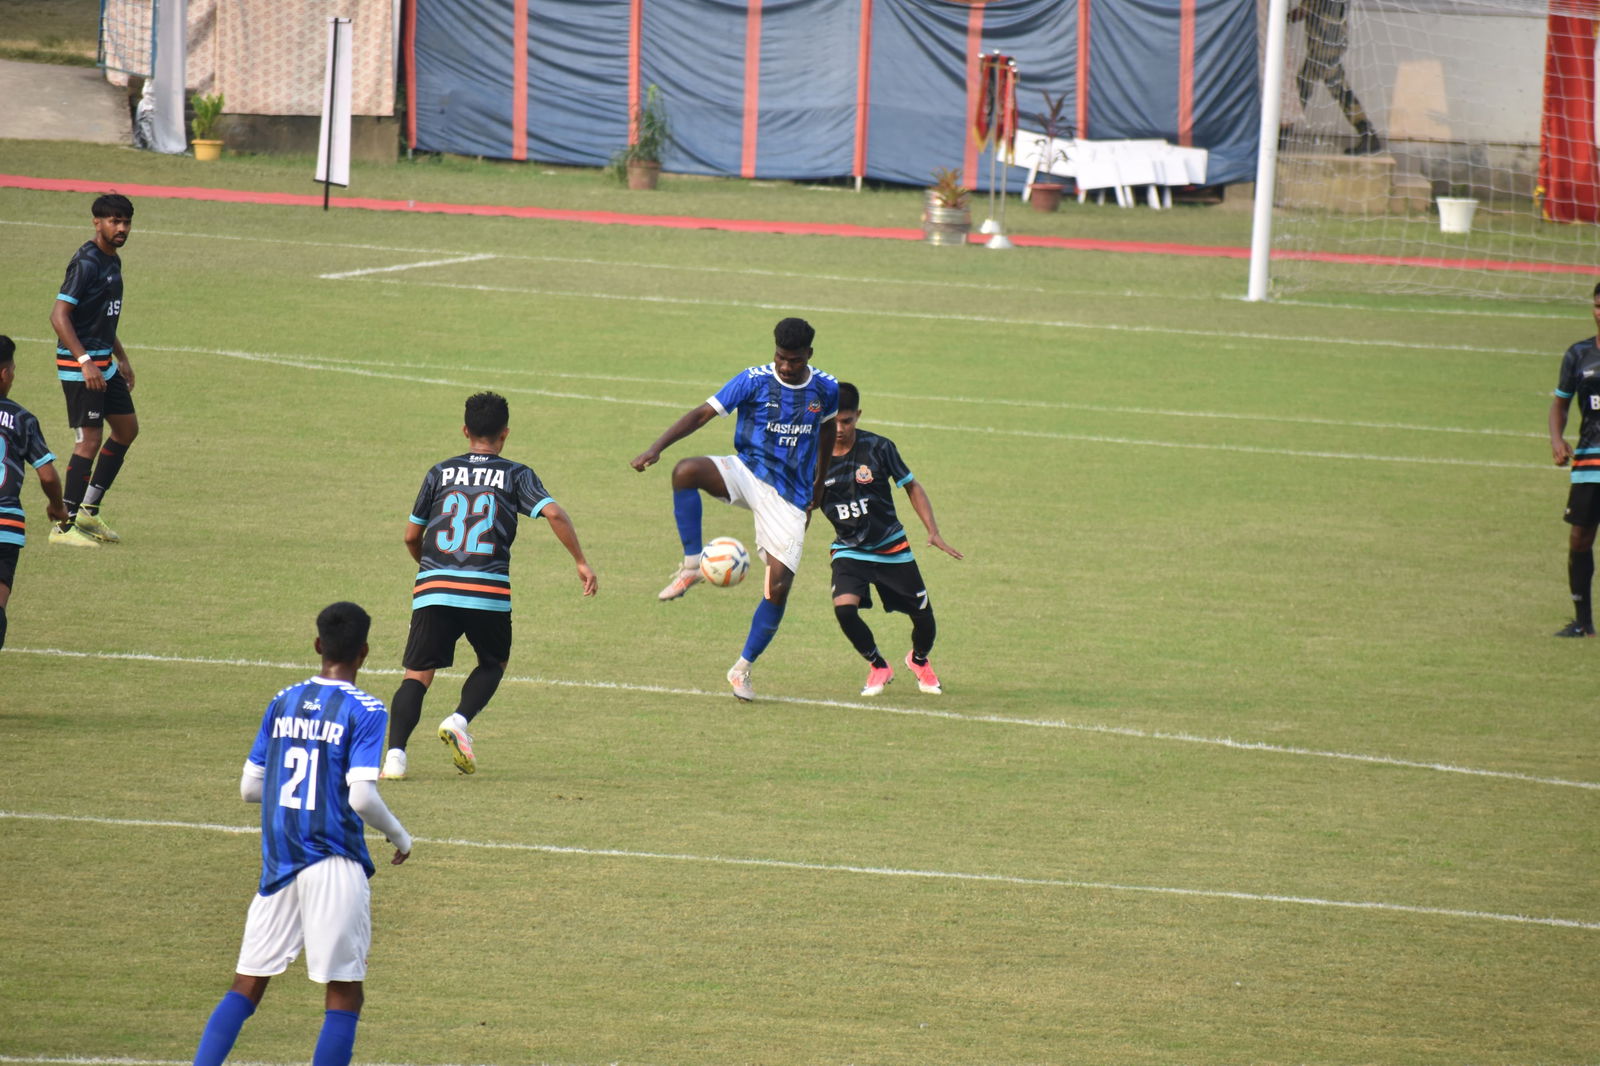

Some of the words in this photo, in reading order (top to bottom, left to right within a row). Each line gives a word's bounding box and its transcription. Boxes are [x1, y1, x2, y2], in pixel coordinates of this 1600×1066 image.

[766, 421, 813, 435] KASHMIR
[441, 466, 505, 490] PATIA
[835, 498, 869, 520] BSF
[435, 490, 498, 556] 32
[916, 590, 928, 610] 7
[279, 746, 320, 811] 21
